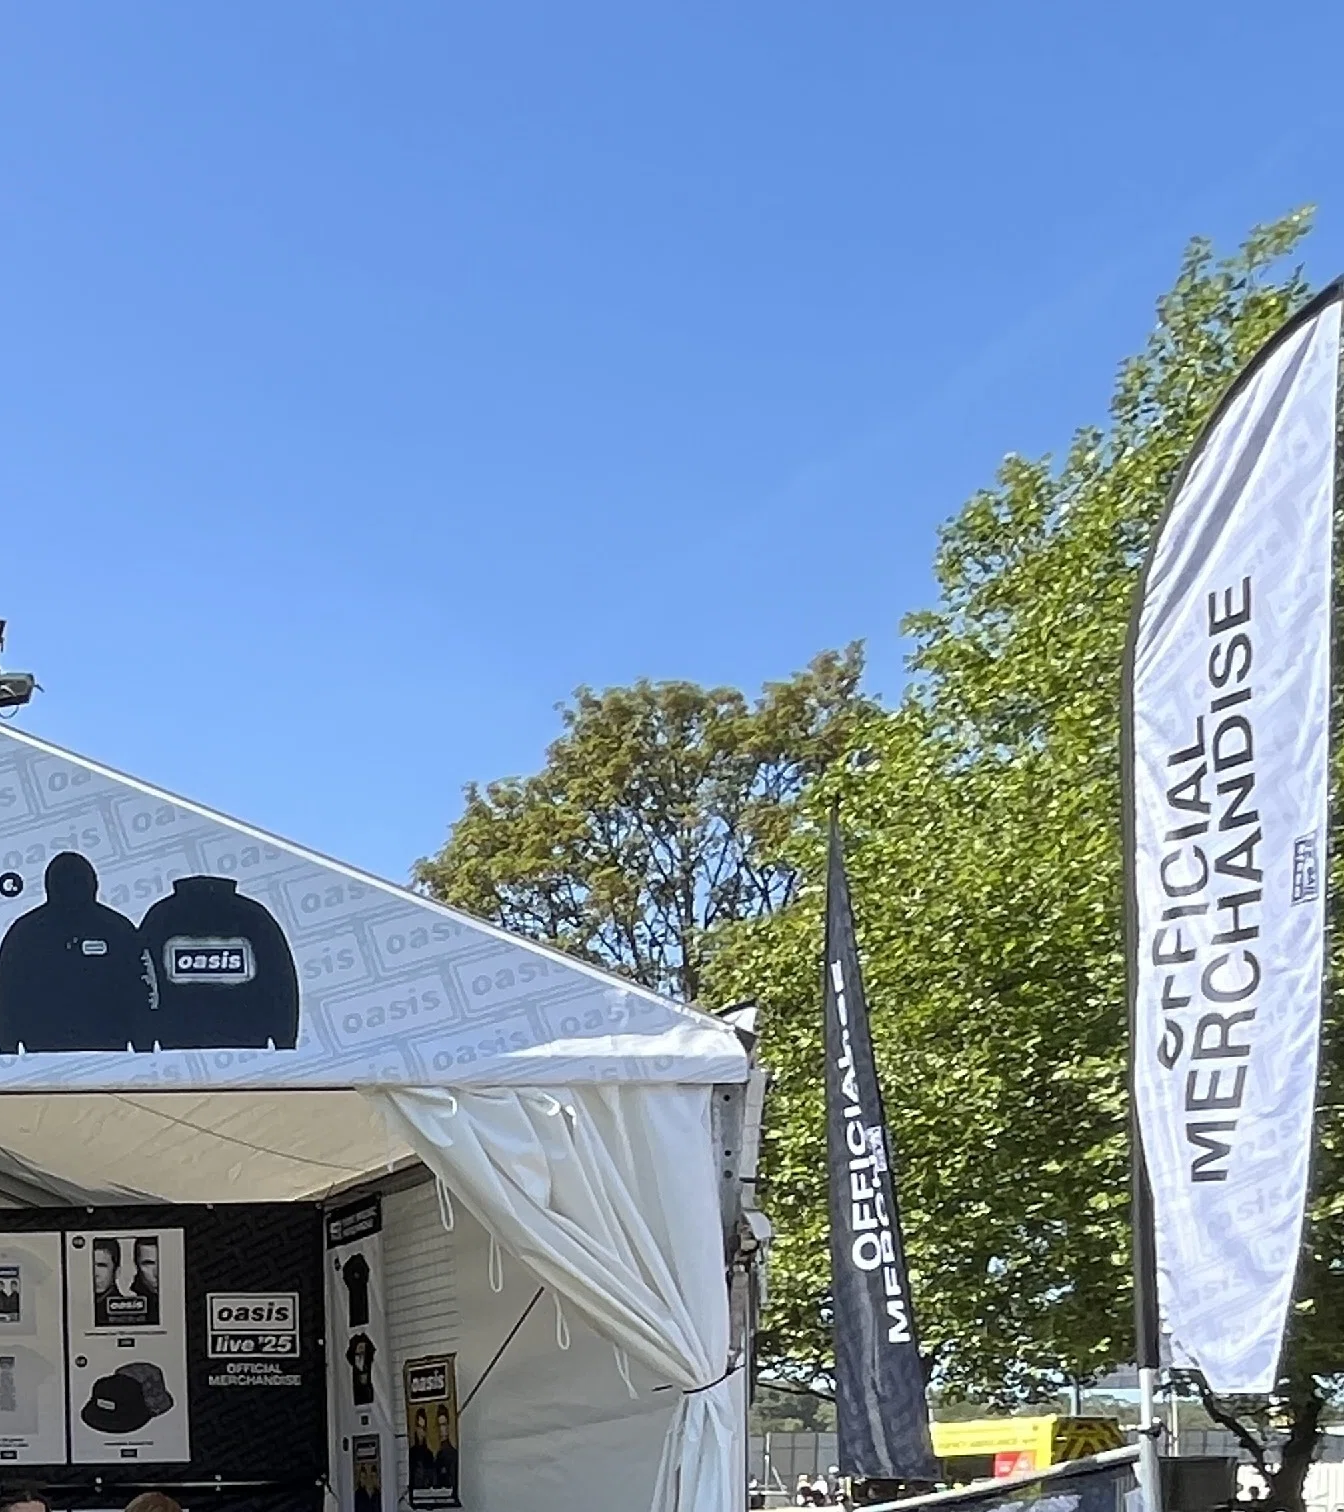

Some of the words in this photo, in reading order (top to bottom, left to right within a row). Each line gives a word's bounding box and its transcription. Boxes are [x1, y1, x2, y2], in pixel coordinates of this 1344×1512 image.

[1184, 576, 1264, 1183] MERCHANDISE
[178, 948, 242, 971] oasis
[340, 984, 442, 1034] oasis
[432, 1027, 530, 1071] oasis
[217, 1301, 290, 1322] oasis
[216, 1335, 255, 1352] live
[226, 1362, 283, 1374] OFFICIAL
[208, 1374, 302, 1386] MERCHANDISE
